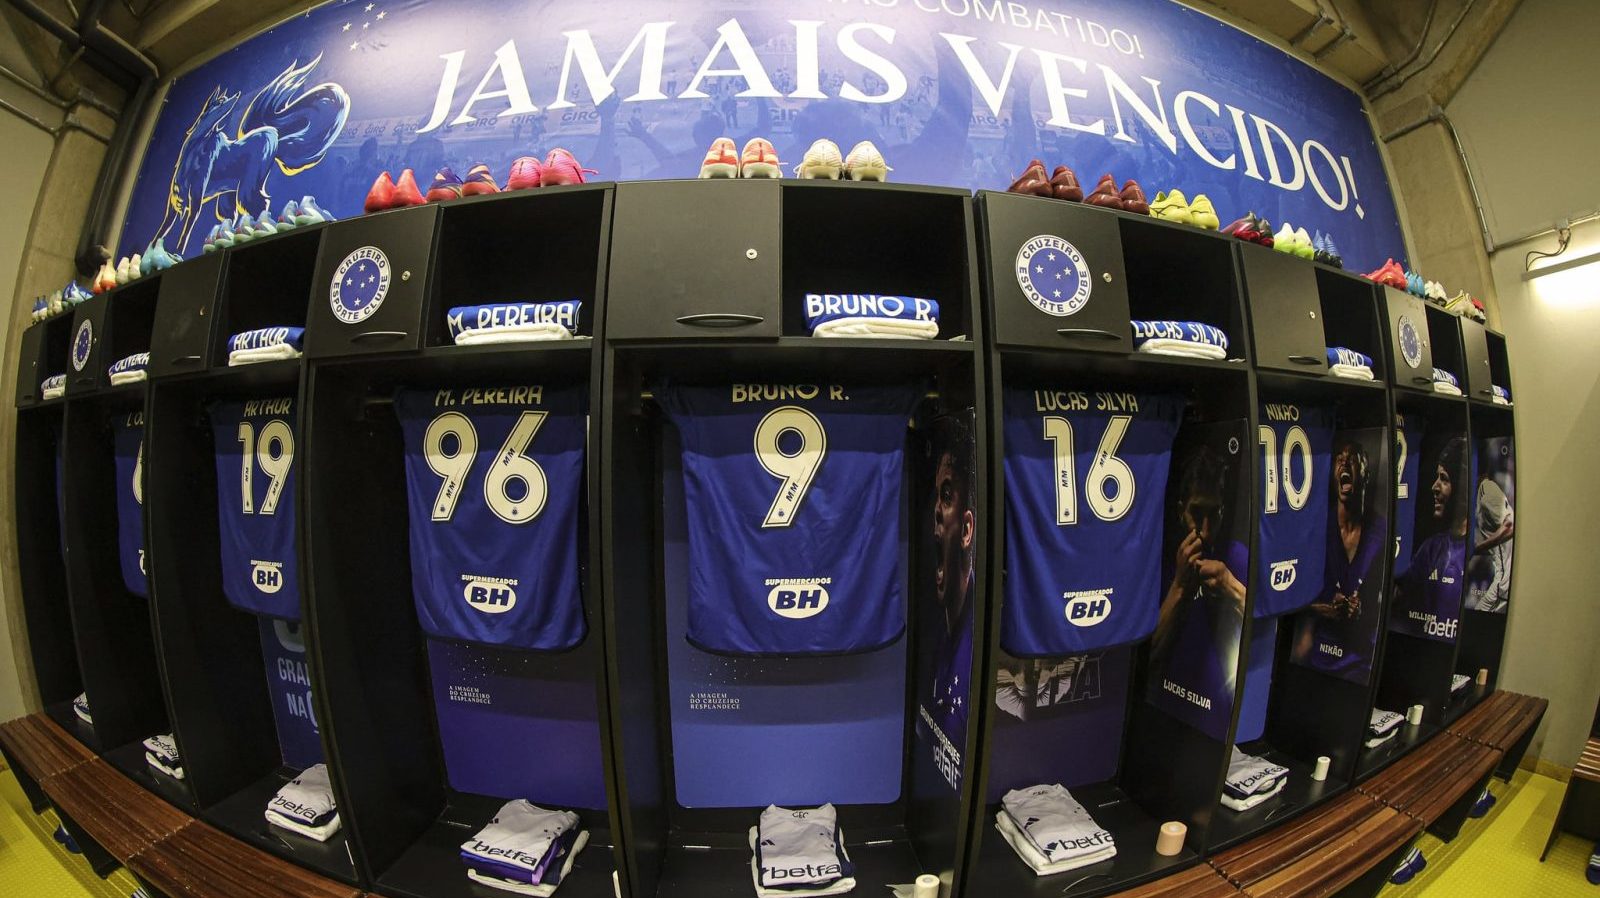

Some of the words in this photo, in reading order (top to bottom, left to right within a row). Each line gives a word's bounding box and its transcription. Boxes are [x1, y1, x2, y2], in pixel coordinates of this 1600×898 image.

[415, 17, 908, 134] JAMAIS
[939, 31, 1365, 219] VENCIDO!
[340, 249, 386, 275] CRUZEIRO
[1022, 238, 1080, 263] CRUZEIRO
[332, 281, 360, 320] ESPORTE
[363, 275, 388, 315] CLUBE
[1019, 266, 1064, 312] ESPORTE
[1068, 270, 1088, 309] CLUBE
[806, 294, 905, 318] BRUNO
[914, 298, 937, 322] R.
[447, 311, 473, 338] M.
[477, 302, 575, 330] PEREIRA
[233, 327, 289, 351] ARTHUR
[1130, 320, 1184, 340] LUCAS
[1187, 323, 1229, 350] SILVA
[435, 389, 456, 407] M.
[461, 385, 544, 406] PEREIRA
[732, 383, 820, 403] BRUNO
[829, 384, 851, 401] R.
[1034, 390, 1089, 412] LUCAS
[1097, 391, 1140, 413] SILVA
[244, 399, 292, 418] ARTHUR
[237, 419, 295, 516] 19
[423, 410, 550, 525] 96
[753, 405, 828, 529] 9
[1043, 415, 1136, 526] 16
[1258, 424, 1314, 514] 10
[257, 569, 279, 587] BH
[461, 574, 519, 586] SUPERMERCADOS
[765, 577, 832, 586] SUPERMERCADOS
[1273, 568, 1294, 586] BH
[470, 586, 510, 606] BH
[775, 589, 821, 610] BH
[1070, 599, 1107, 620] BH
[1408, 610, 1437, 622] WILLIAM
[1427, 617, 1459, 638] betf
[1319, 643, 1343, 658] NIKÃO
[277, 657, 311, 687] GRA
[450, 695, 492, 704] RESPLANDECE
[459, 691, 490, 699] CRUZEIRO
[1163, 679, 1186, 698] LUCAS
[1186, 690, 1211, 711] SILVA
[771, 863, 841, 880] betfa
